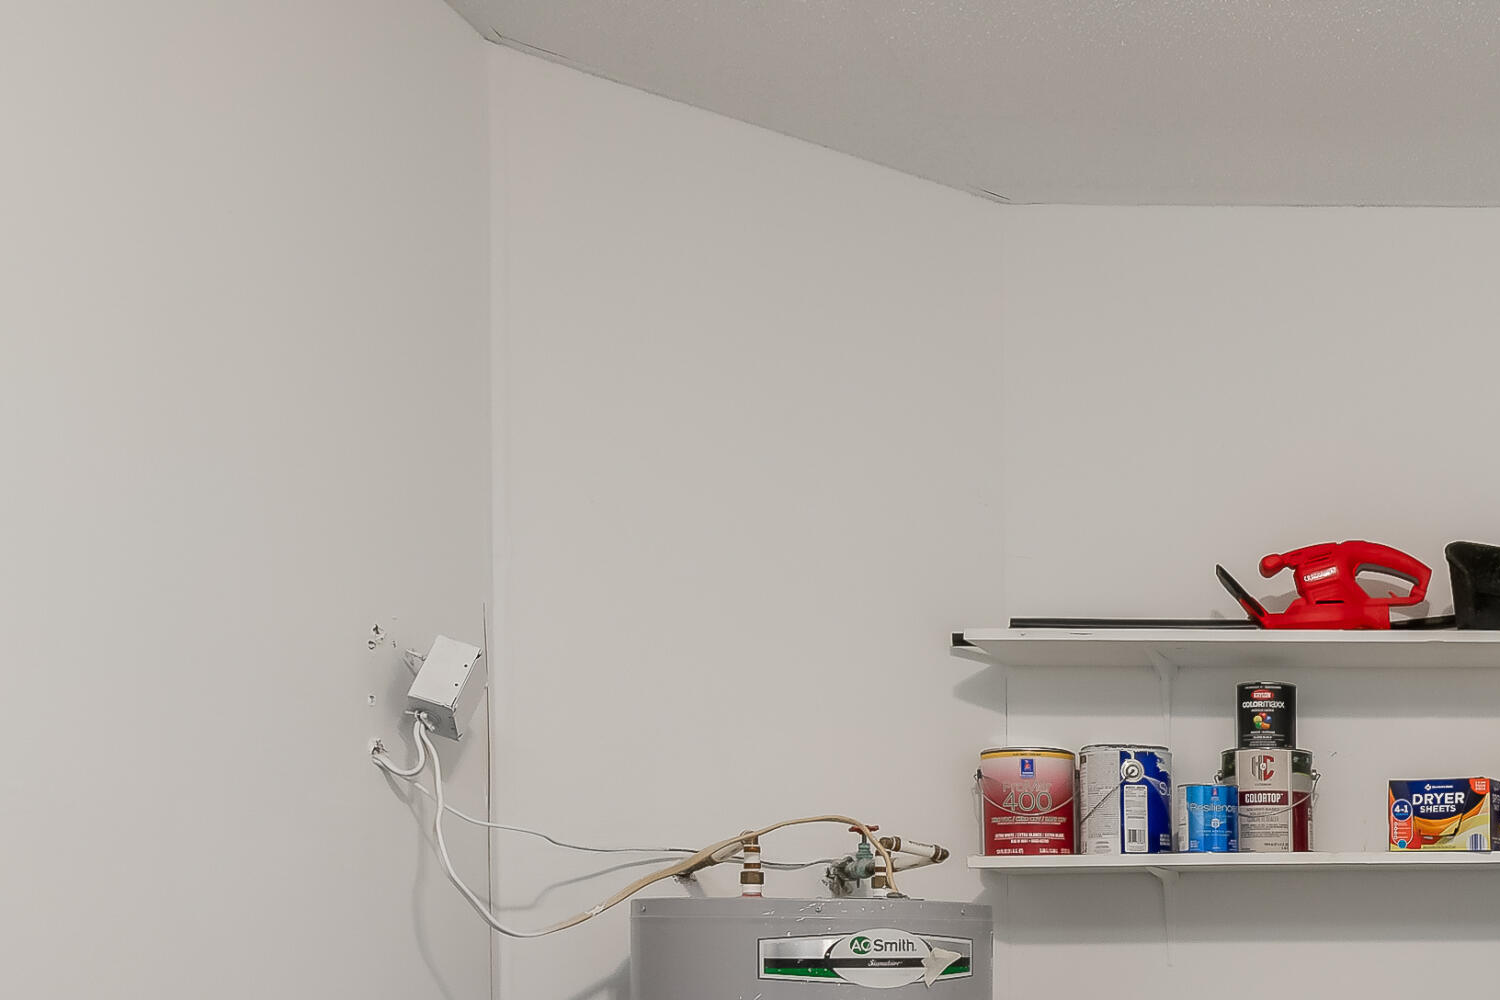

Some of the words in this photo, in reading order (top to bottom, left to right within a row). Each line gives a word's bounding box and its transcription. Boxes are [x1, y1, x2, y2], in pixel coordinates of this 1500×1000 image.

[1002, 792, 1053, 812] 400
[1244, 793, 1281, 803] COLORTOP
[1412, 792, 1465, 805] DRYER
[1419, 805, 1457, 813] SHEETS
[873, 939, 915, 952] Smith
